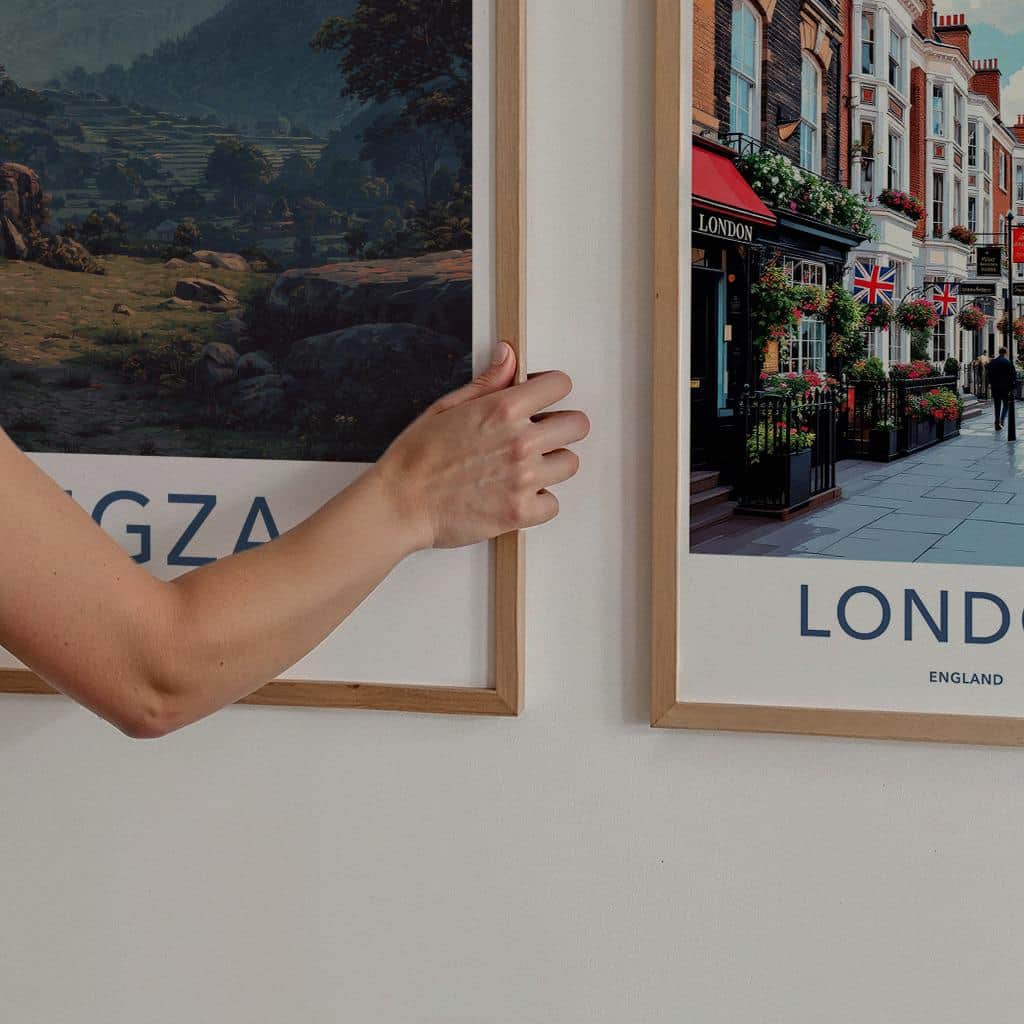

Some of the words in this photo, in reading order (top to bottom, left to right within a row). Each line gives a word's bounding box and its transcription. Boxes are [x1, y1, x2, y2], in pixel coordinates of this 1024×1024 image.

[698, 213, 753, 242] LONDON
[800, 584, 1024, 645] LOND
[929, 670, 1004, 686] ENGLAND
